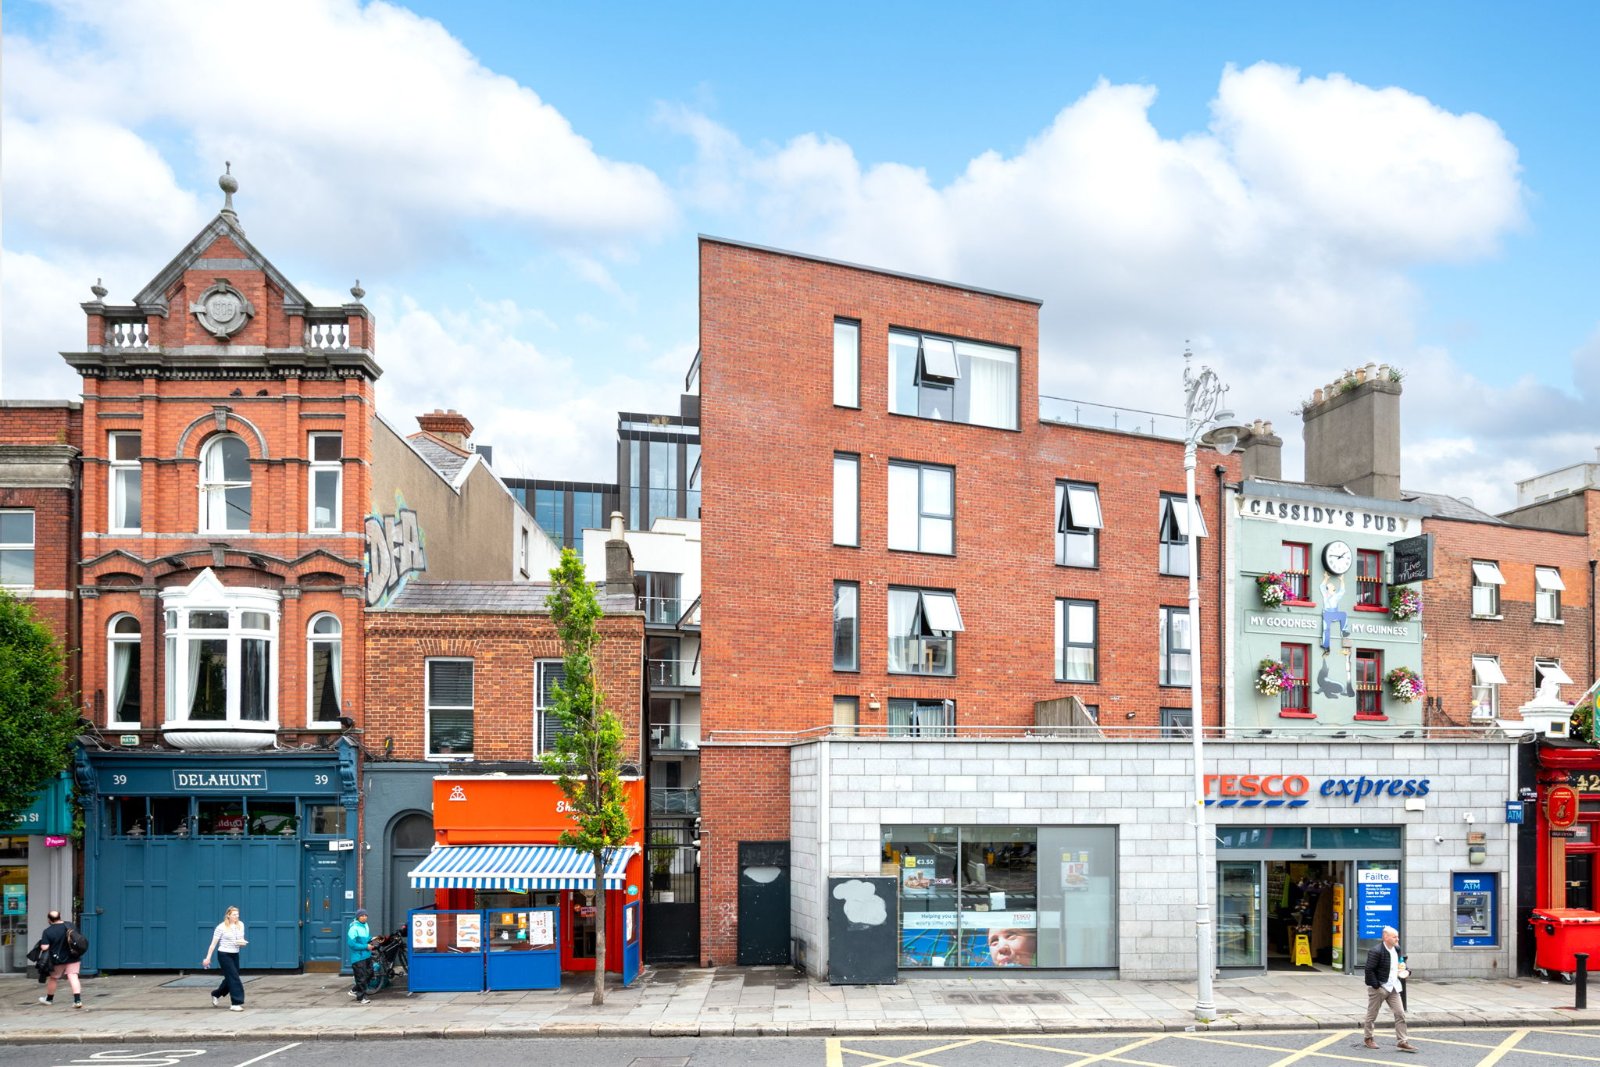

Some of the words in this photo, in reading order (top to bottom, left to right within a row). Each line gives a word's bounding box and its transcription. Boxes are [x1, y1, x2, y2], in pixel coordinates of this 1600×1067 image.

[1250, 499, 1354, 527] CASSIDY'S
[1363, 513, 1397, 532] PUB
[1250, 616, 1264, 626] MY
[1266, 617, 1318, 629] GOODNESS
[1352, 623, 1365, 634] MY
[1366, 624, 1408, 636] GUINNESS
[112, 774, 127, 785] 39
[178, 774, 262, 786] DELAHUNT
[314, 774, 329, 785] 39
[1203, 774, 1310, 797] TESCO
[1319, 775, 1431, 803] express
[1507, 810, 1522, 820] ATM
